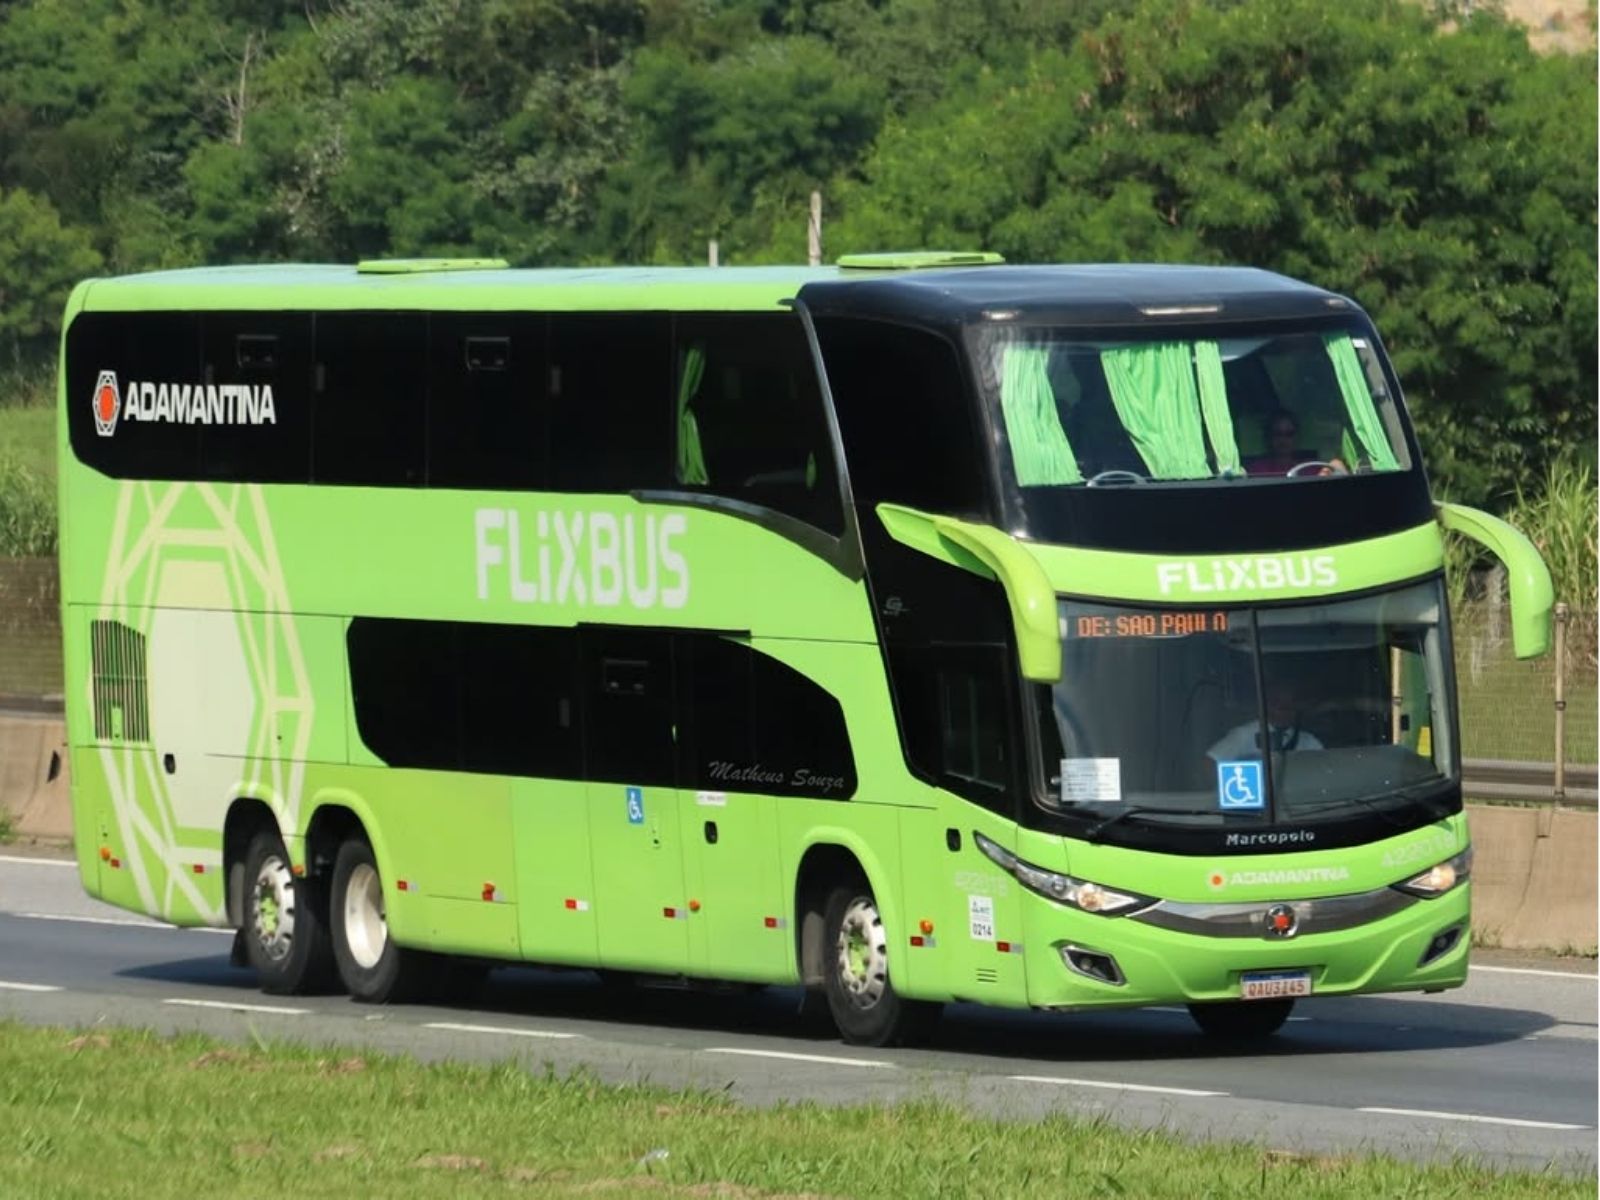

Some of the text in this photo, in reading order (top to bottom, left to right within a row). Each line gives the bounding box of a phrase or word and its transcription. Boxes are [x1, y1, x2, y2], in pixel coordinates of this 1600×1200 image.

[123, 381, 277, 425] ADAMANTINA
[1078, 616, 1111, 637] DE:
[1226, 830, 1315, 846] Marcopolo
[1230, 867, 1349, 886] ADAMANTINA
[972, 923, 992, 937] 0214
